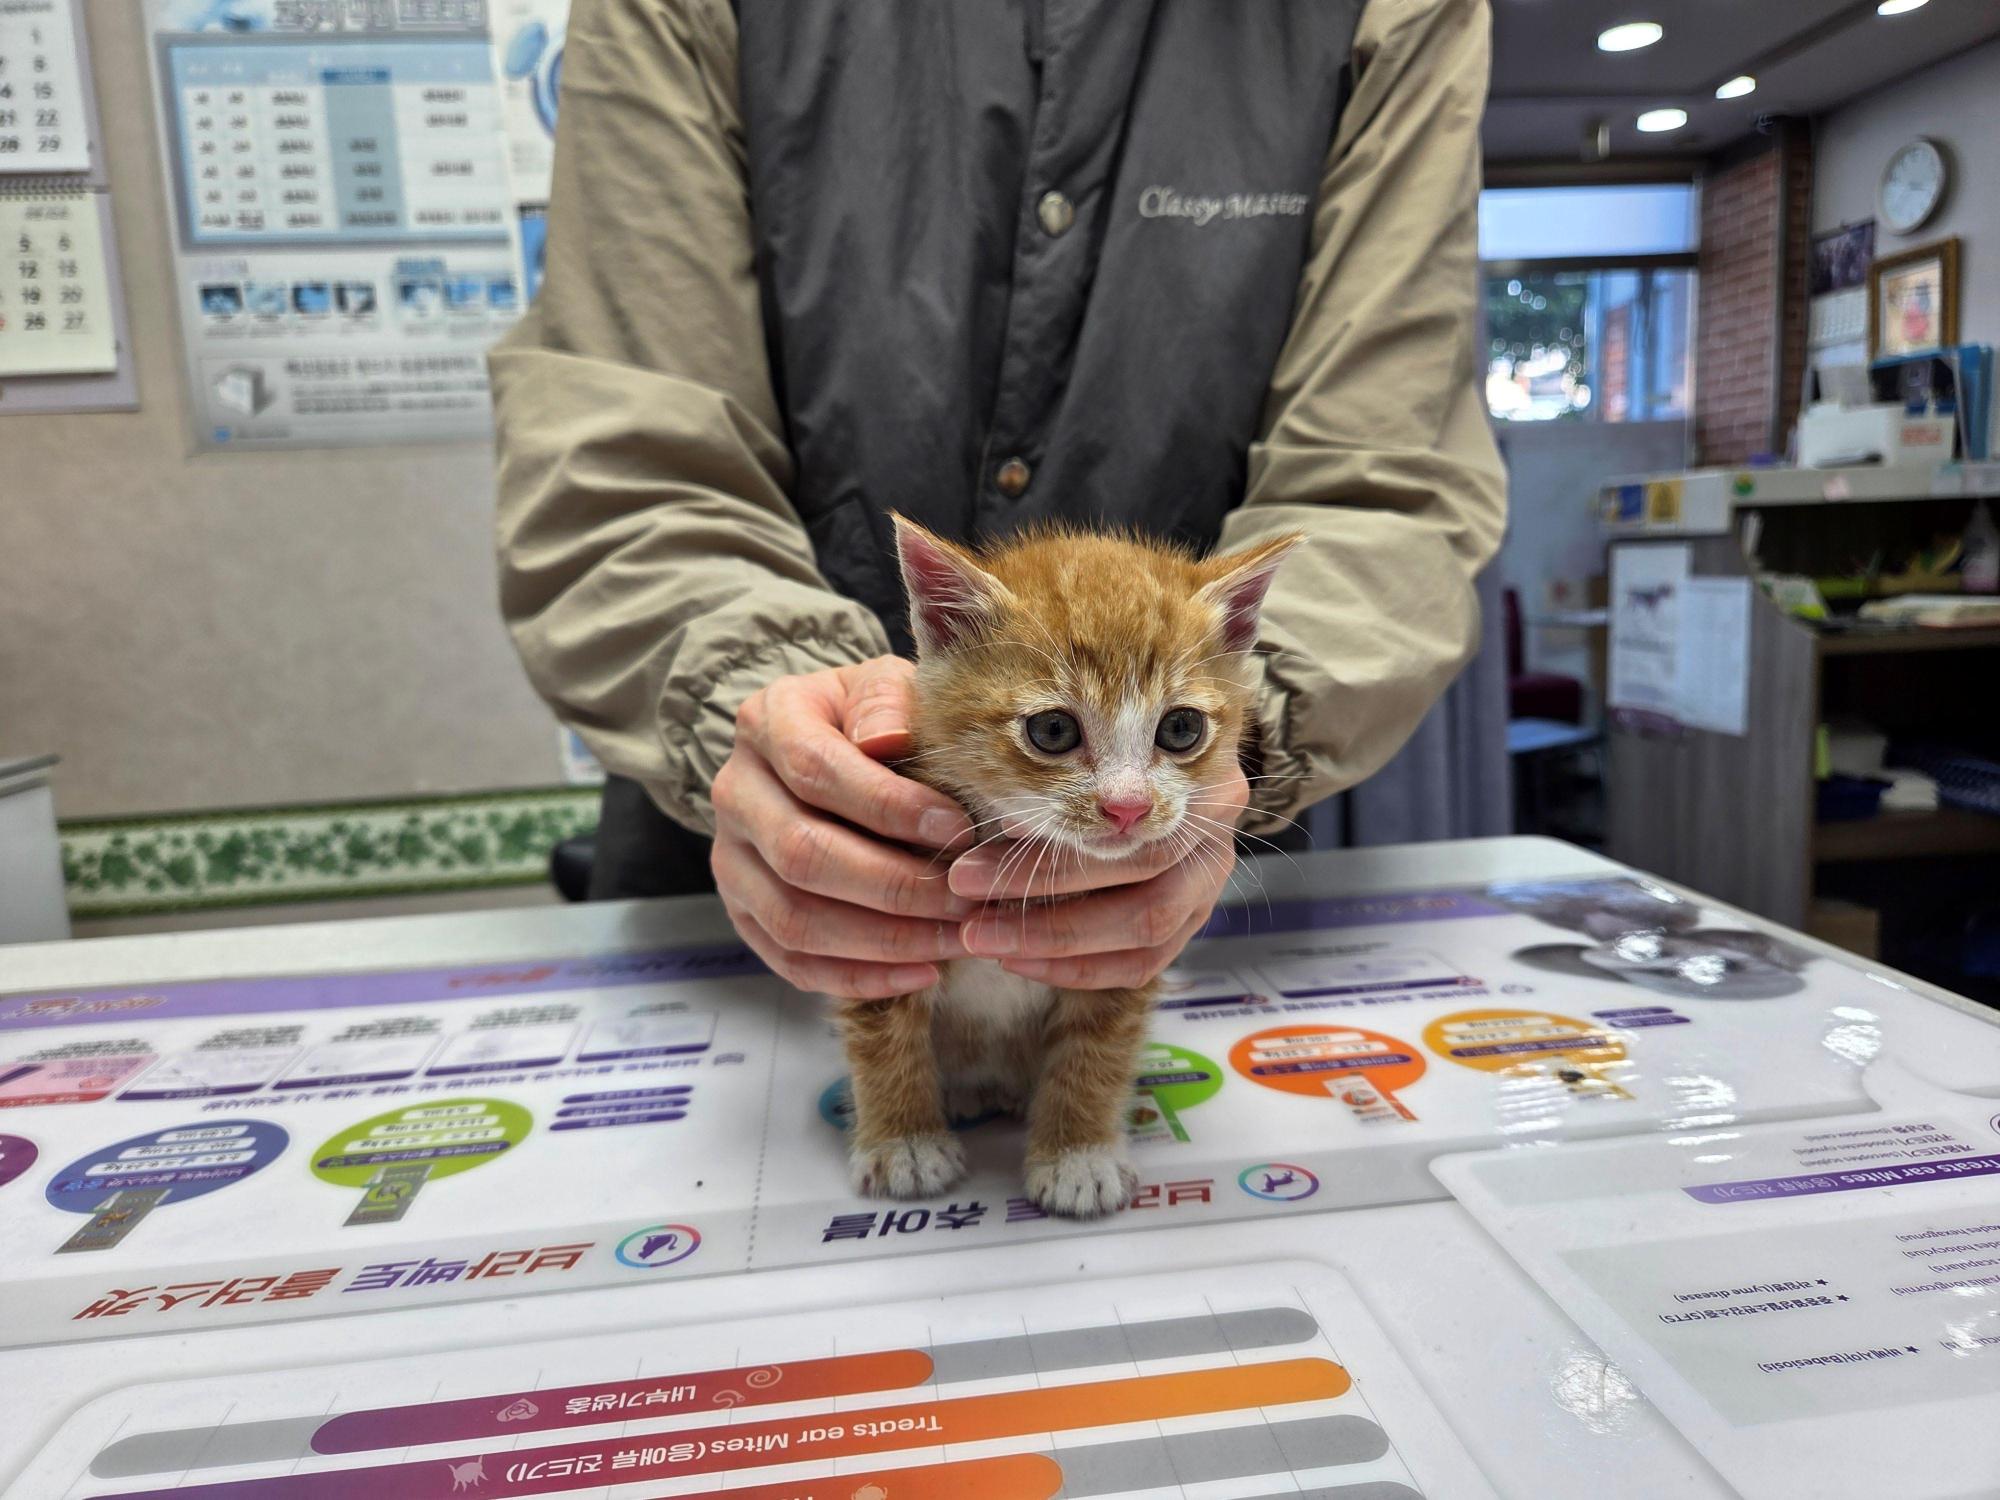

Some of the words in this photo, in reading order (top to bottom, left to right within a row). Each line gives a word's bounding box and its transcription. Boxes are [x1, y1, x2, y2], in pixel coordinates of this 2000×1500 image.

[1839, 1169, 1902, 1185] Mites
[1903, 1165, 1936, 1178] ear
[821, 1201, 989, 1243] 츄어블
[341, 1242, 596, 1294] 브라벡토
[71, 1267, 343, 1321] 플러스캣
[1672, 1289, 1731, 1303] disease)
[1757, 1348, 1903, 1374] 바베시아(Babesiosis)
[564, 1383, 698, 1415] 내부기생충
[797, 1426, 845, 1447] ear
[852, 1415, 943, 1437] Treats
[611, 1440, 706, 1471] (응애류
[710, 1432, 790, 1458] Mites
[505, 1453, 604, 1483] 진드기)
